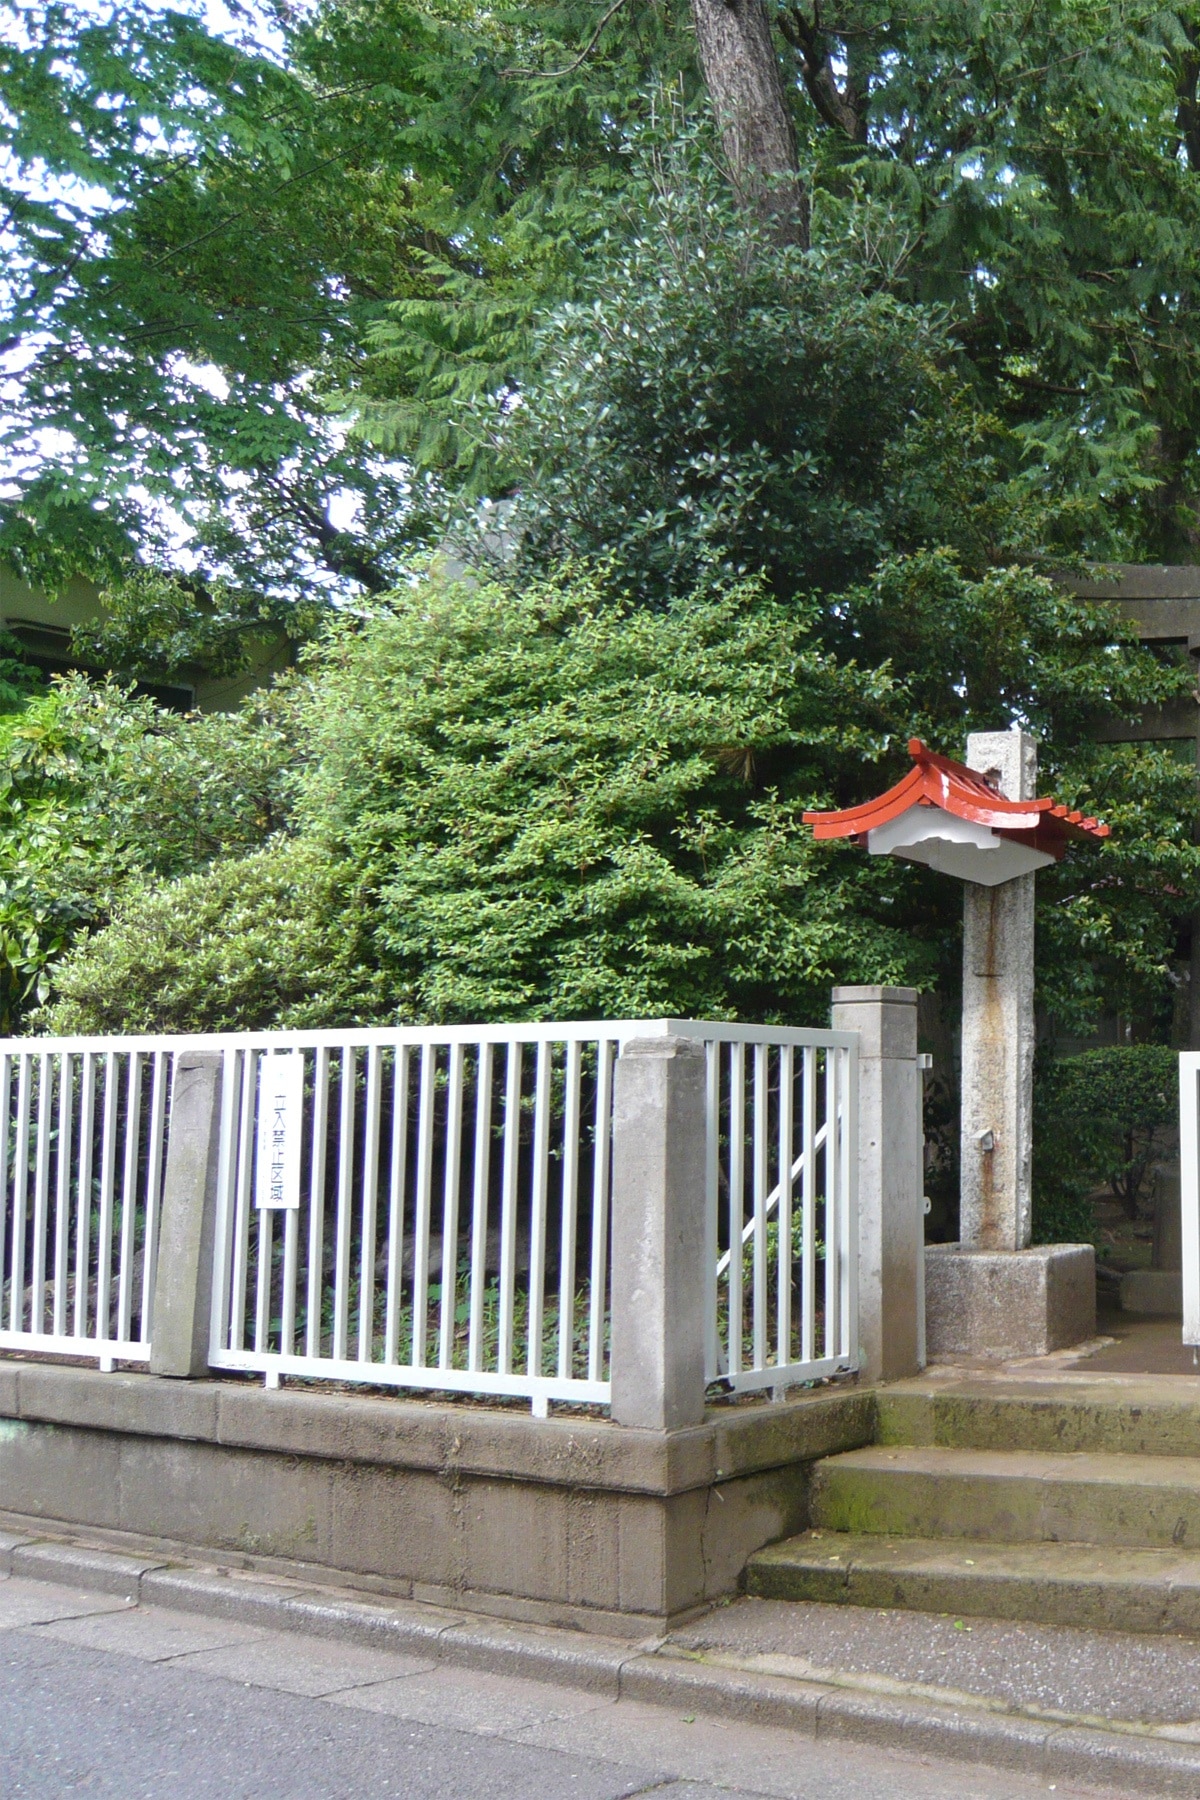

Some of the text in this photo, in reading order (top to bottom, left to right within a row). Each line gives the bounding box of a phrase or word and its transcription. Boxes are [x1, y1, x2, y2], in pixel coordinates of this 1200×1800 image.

[270, 1094, 287, 1203] 立入禁止区域
